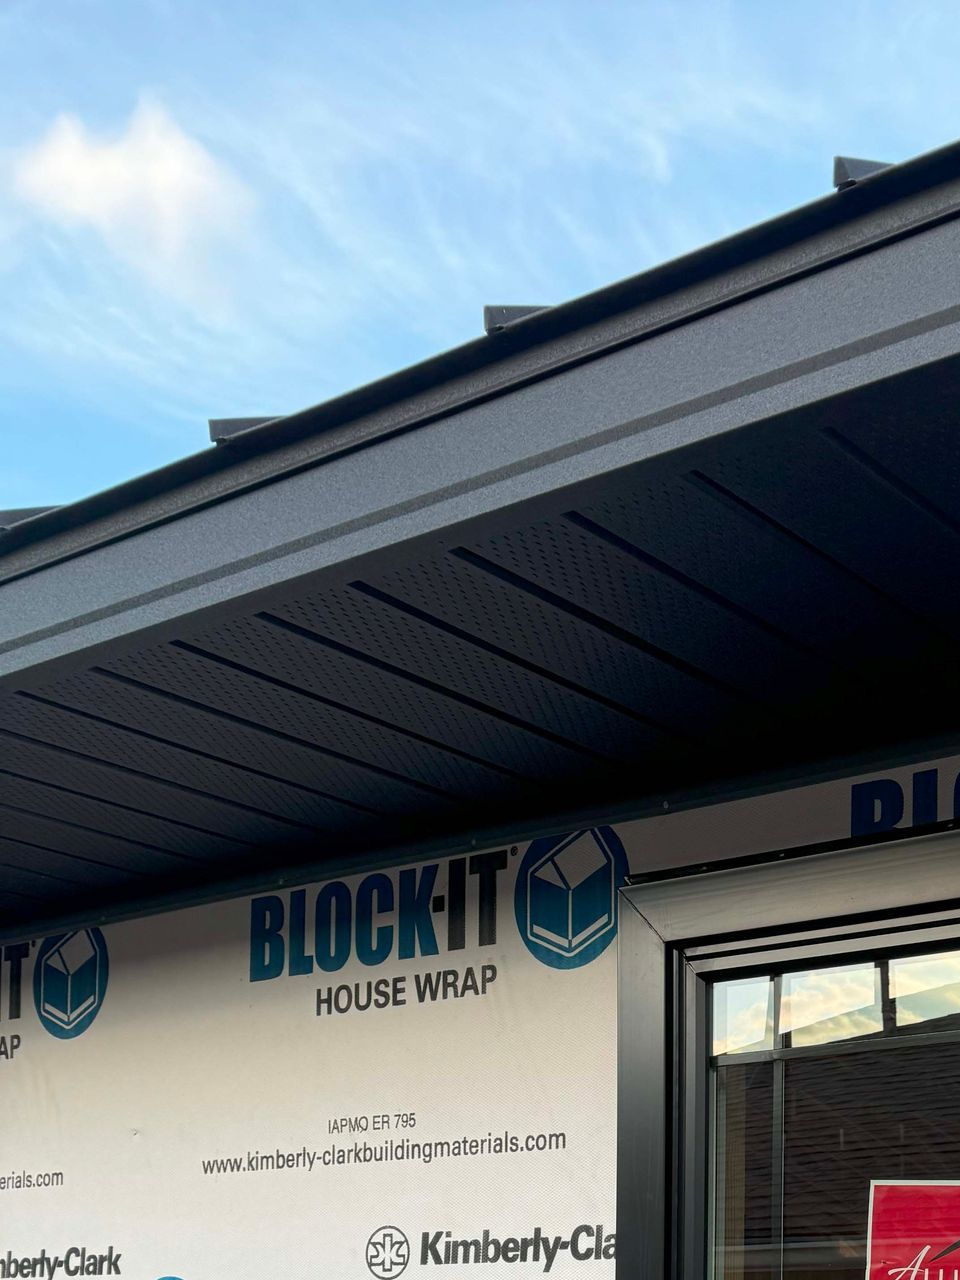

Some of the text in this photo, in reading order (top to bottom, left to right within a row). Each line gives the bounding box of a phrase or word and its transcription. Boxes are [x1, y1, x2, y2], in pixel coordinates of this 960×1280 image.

[315, 964, 498, 1016] HOUSE WRAP
[328, 1112, 416, 1134] IAPMO ER 795
[202, 1131, 566, 1175] www.kimberly-clarkbuildingmaterials.com
